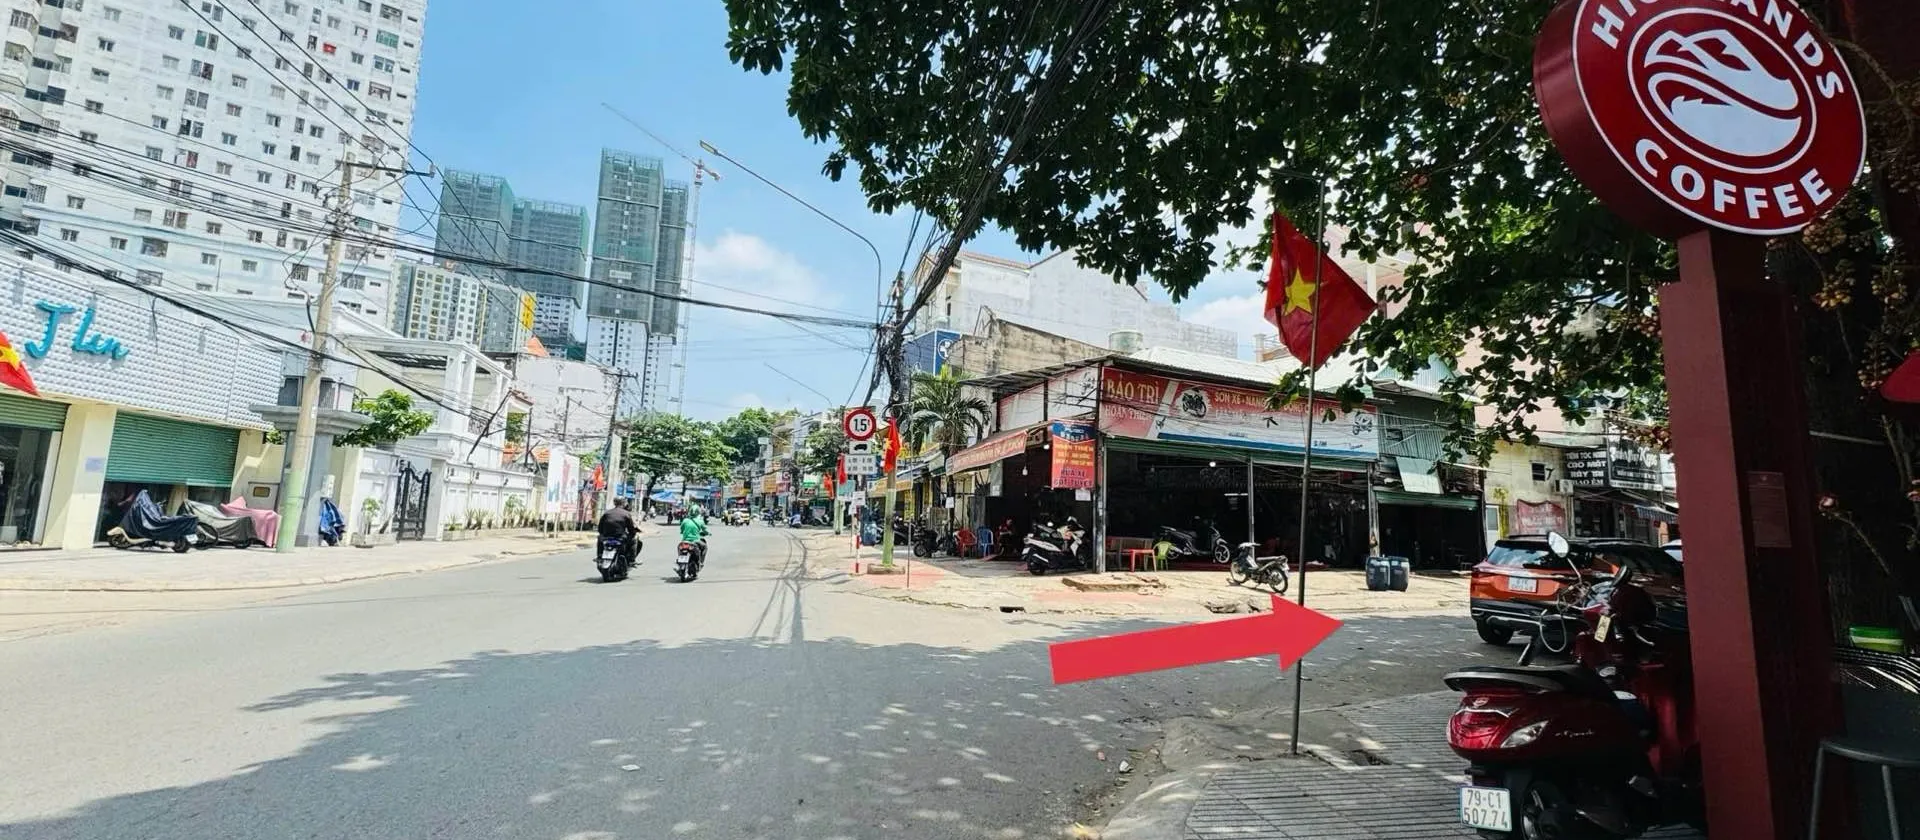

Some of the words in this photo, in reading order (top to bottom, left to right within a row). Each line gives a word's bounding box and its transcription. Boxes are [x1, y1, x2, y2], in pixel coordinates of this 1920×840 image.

[1591, 0, 1844, 99] HIANDS
[1635, 138, 1832, 219] COFFEE
[1464, 809, 1508, 829] 507.74
[1467, 789, 1502, 807] 79-C1
